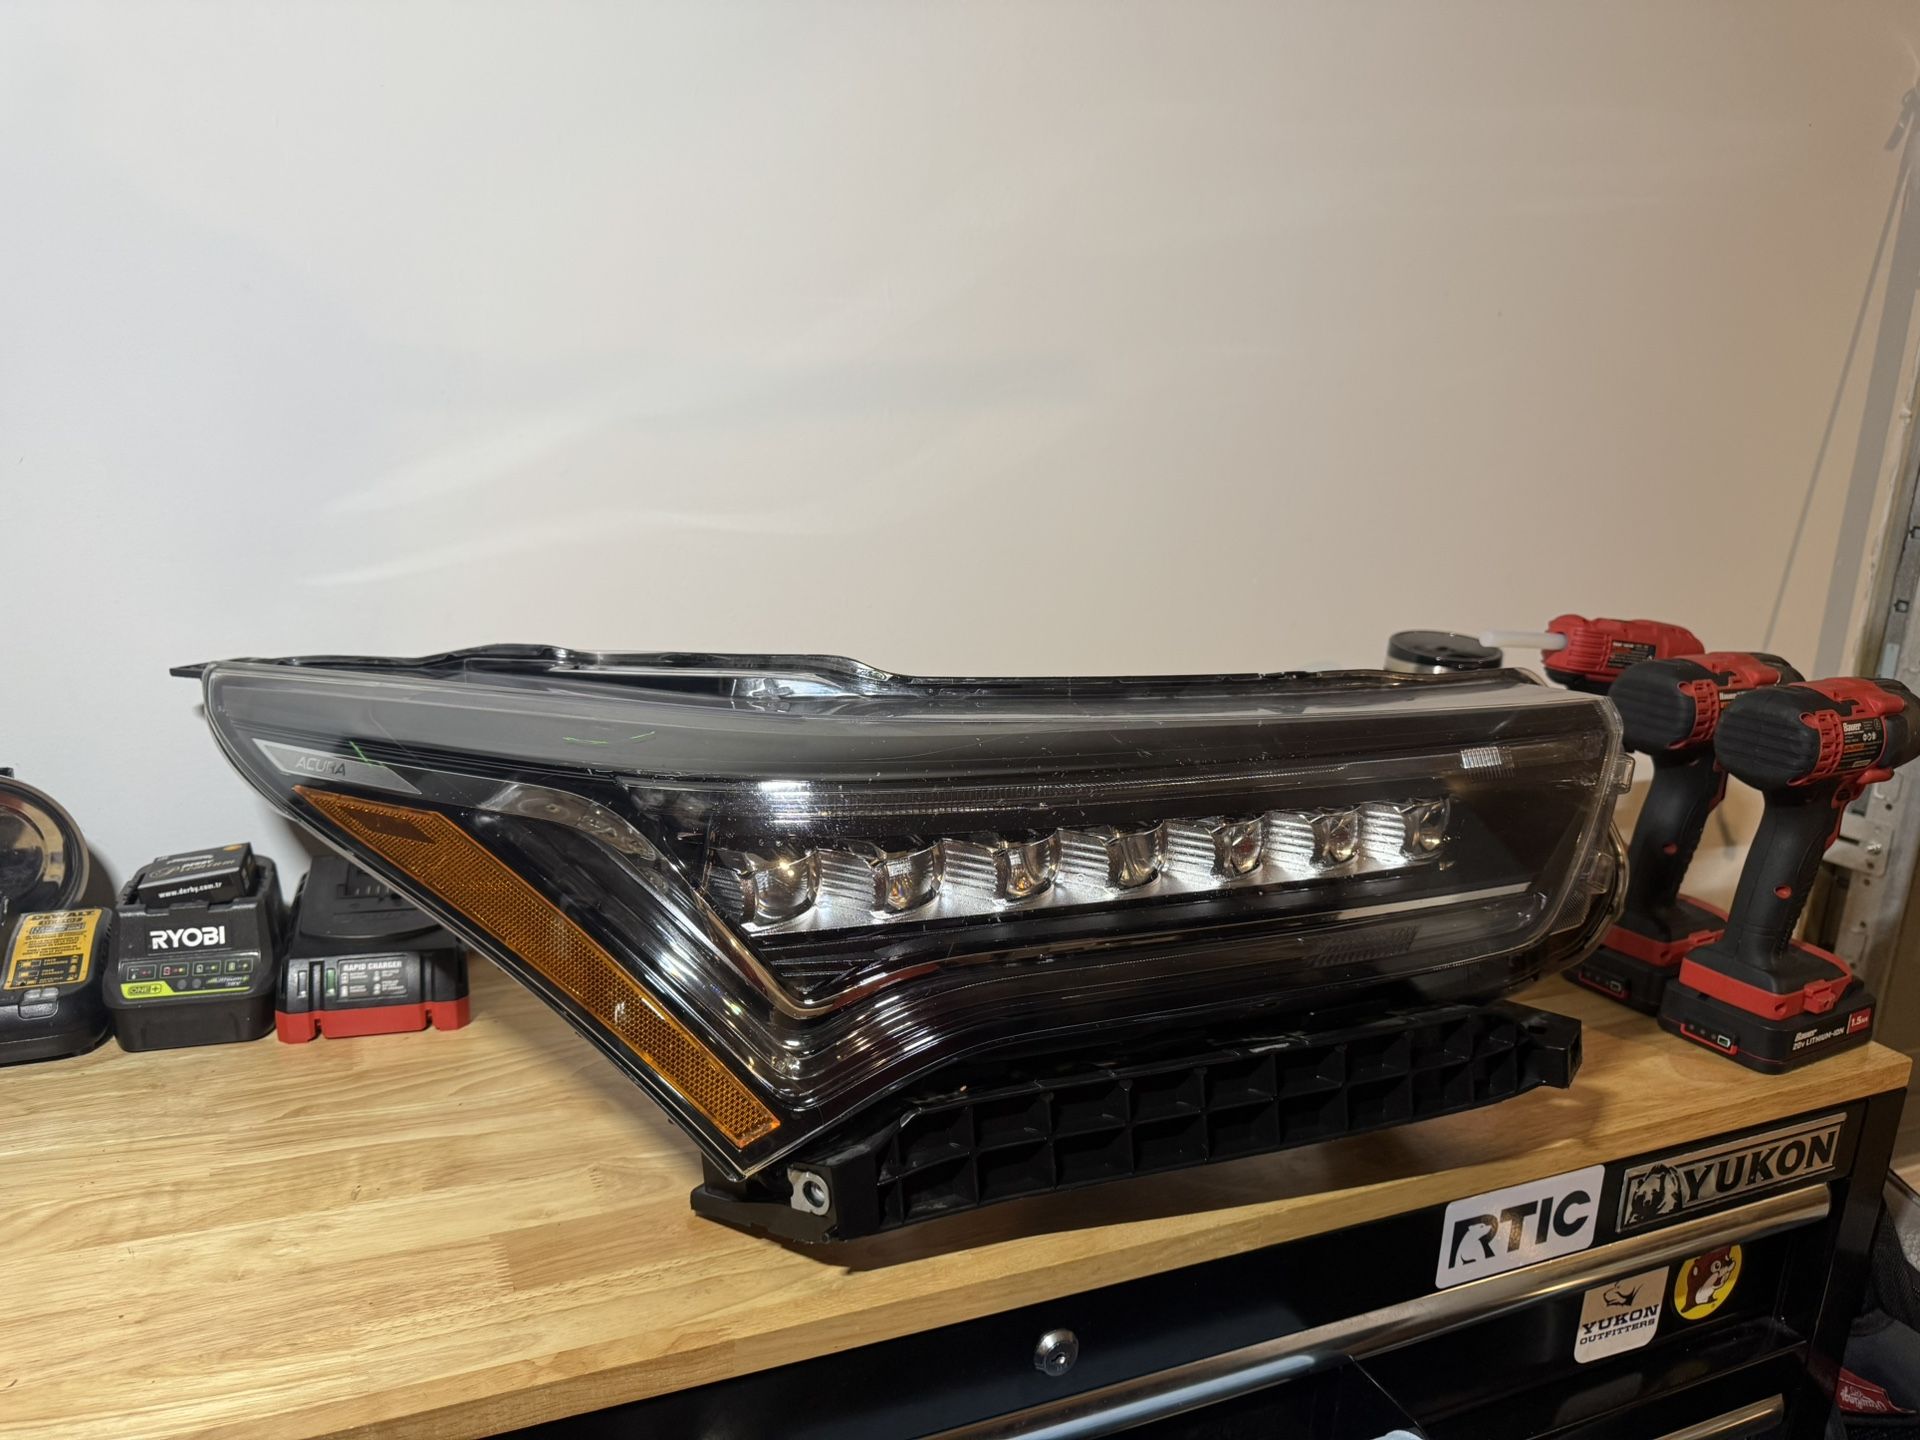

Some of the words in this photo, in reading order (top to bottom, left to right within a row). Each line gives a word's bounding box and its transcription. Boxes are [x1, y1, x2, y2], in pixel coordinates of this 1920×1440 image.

[296, 756, 346, 776] ACURA
[158, 881, 222, 898] www.derby.com.tr
[31, 910, 95, 921] DEWALT
[149, 925, 226, 950] RYOBI
[342, 963, 367, 972] RAPID
[367, 960, 403, 970] CHARGER
[1683, 1130, 1838, 1203] YUKON
[1448, 1190, 1592, 1269] RTIC
[1579, 1318, 1655, 1345] OUTFITTERS
[1582, 1303, 1660, 1335] YUKON
